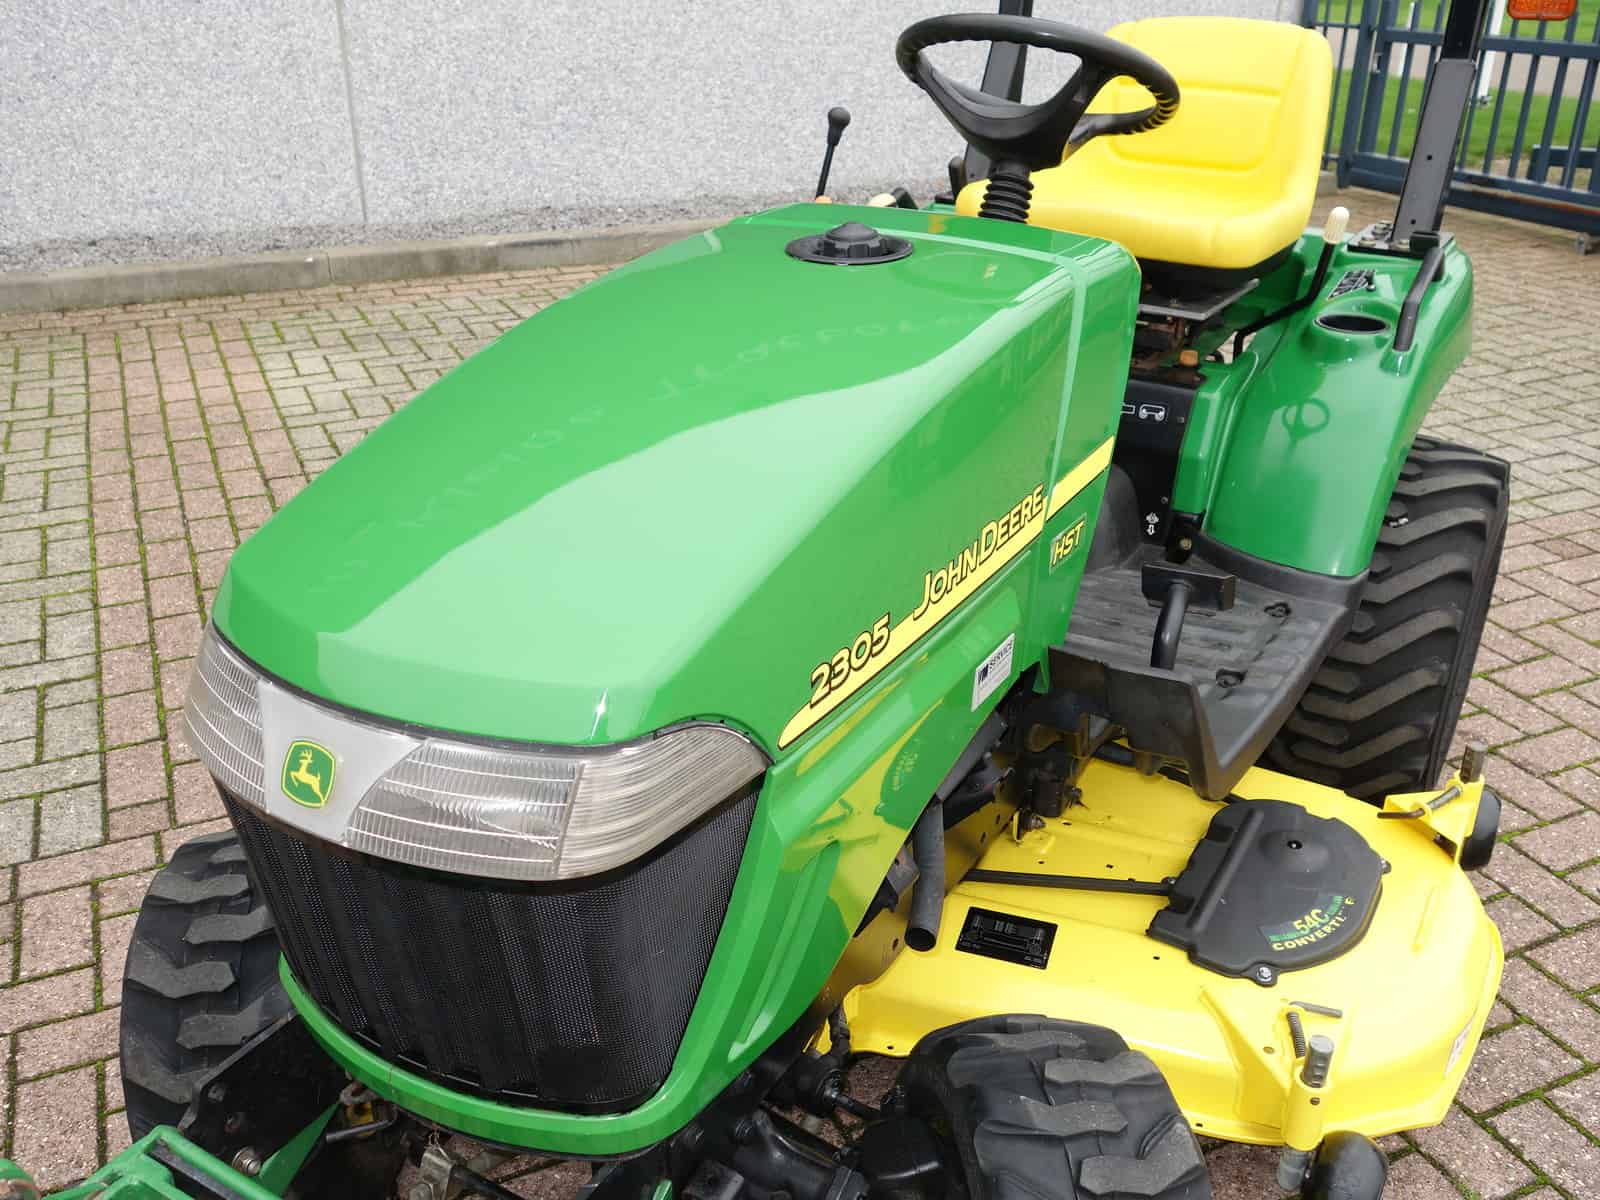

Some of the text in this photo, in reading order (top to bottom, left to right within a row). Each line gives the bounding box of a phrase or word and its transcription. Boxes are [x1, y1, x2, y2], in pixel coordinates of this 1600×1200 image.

[912, 483, 1044, 621] JOHN DEERE
[1051, 518, 1086, 567] HST
[809, 610, 891, 709] 2305
[1292, 907, 1330, 936] 54C
